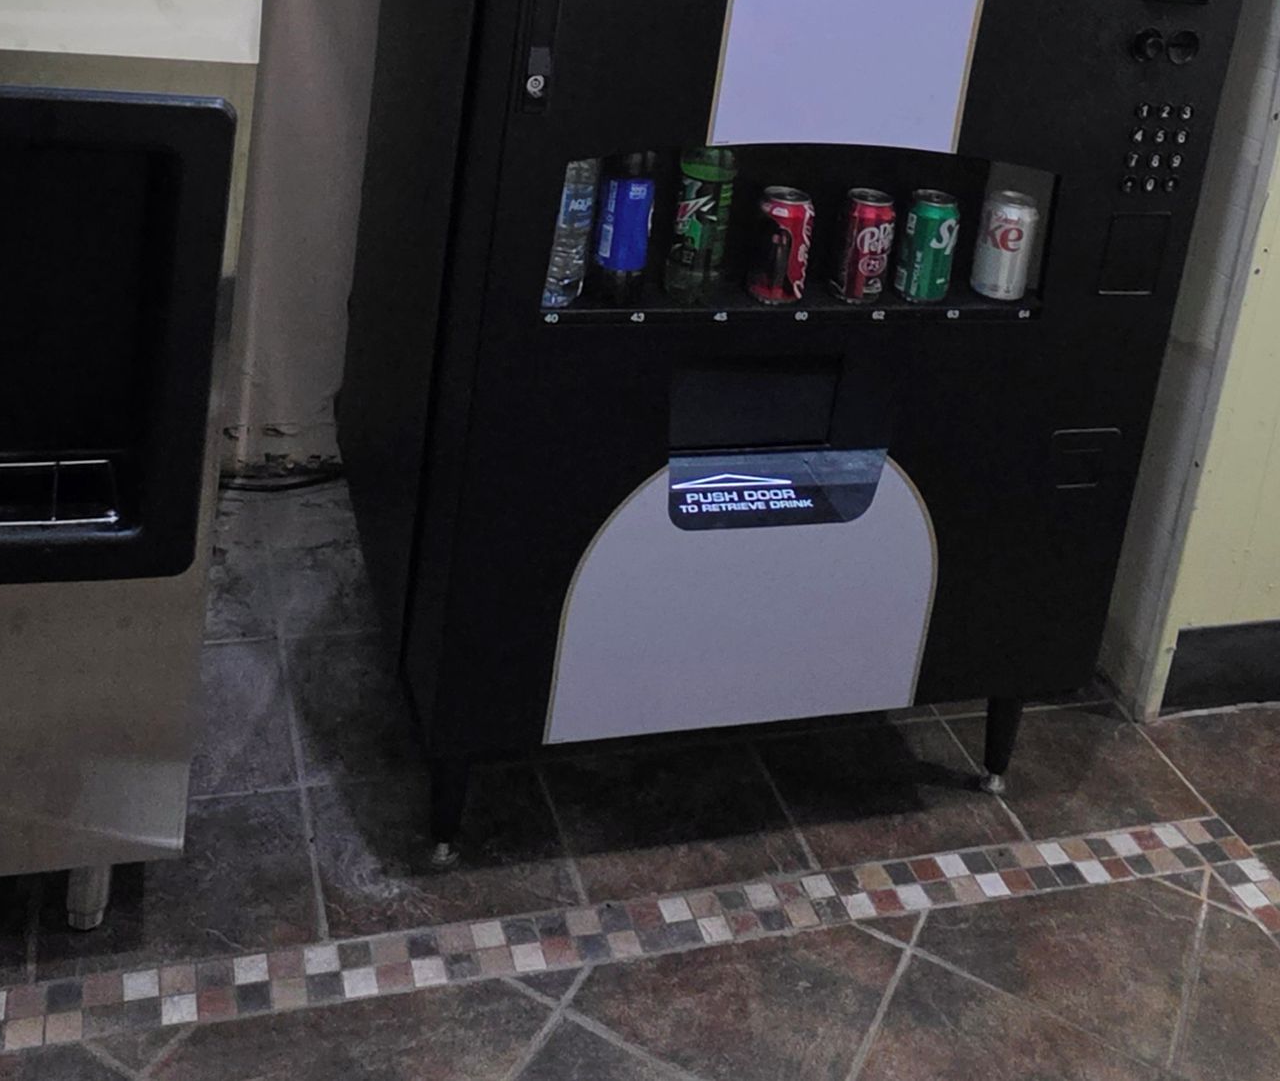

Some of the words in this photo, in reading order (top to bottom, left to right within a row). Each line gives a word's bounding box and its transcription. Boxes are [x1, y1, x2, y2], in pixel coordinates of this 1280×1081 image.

[1142, 105, 1149, 117] 1
[1161, 106, 1170, 118] 2
[1182, 106, 1191, 119] 3
[1134, 129, 1143, 142] 4
[1156, 130, 1165, 142] 5
[1177, 131, 1187, 143] 6
[1129, 154, 1138, 167] 7
[1152, 155, 1160, 167] 8
[1172, 155, 1181, 167] 9
[1146, 179, 1154, 191] 0
[544, 313, 559, 323] 40
[630, 312, 645, 323] 43
[714, 312, 728, 322] 45
[795, 311, 808, 321] 60
[872, 311, 885, 320] 62
[947, 310, 960, 319] 63
[1018, 309, 1030, 318] 64
[686, 491, 738, 503] PUSH
[744, 489, 796, 500] DOOR
[679, 504, 699, 513] TO
[701, 501, 766, 512] RETRIEVE
[769, 499, 814, 509] DRINK
